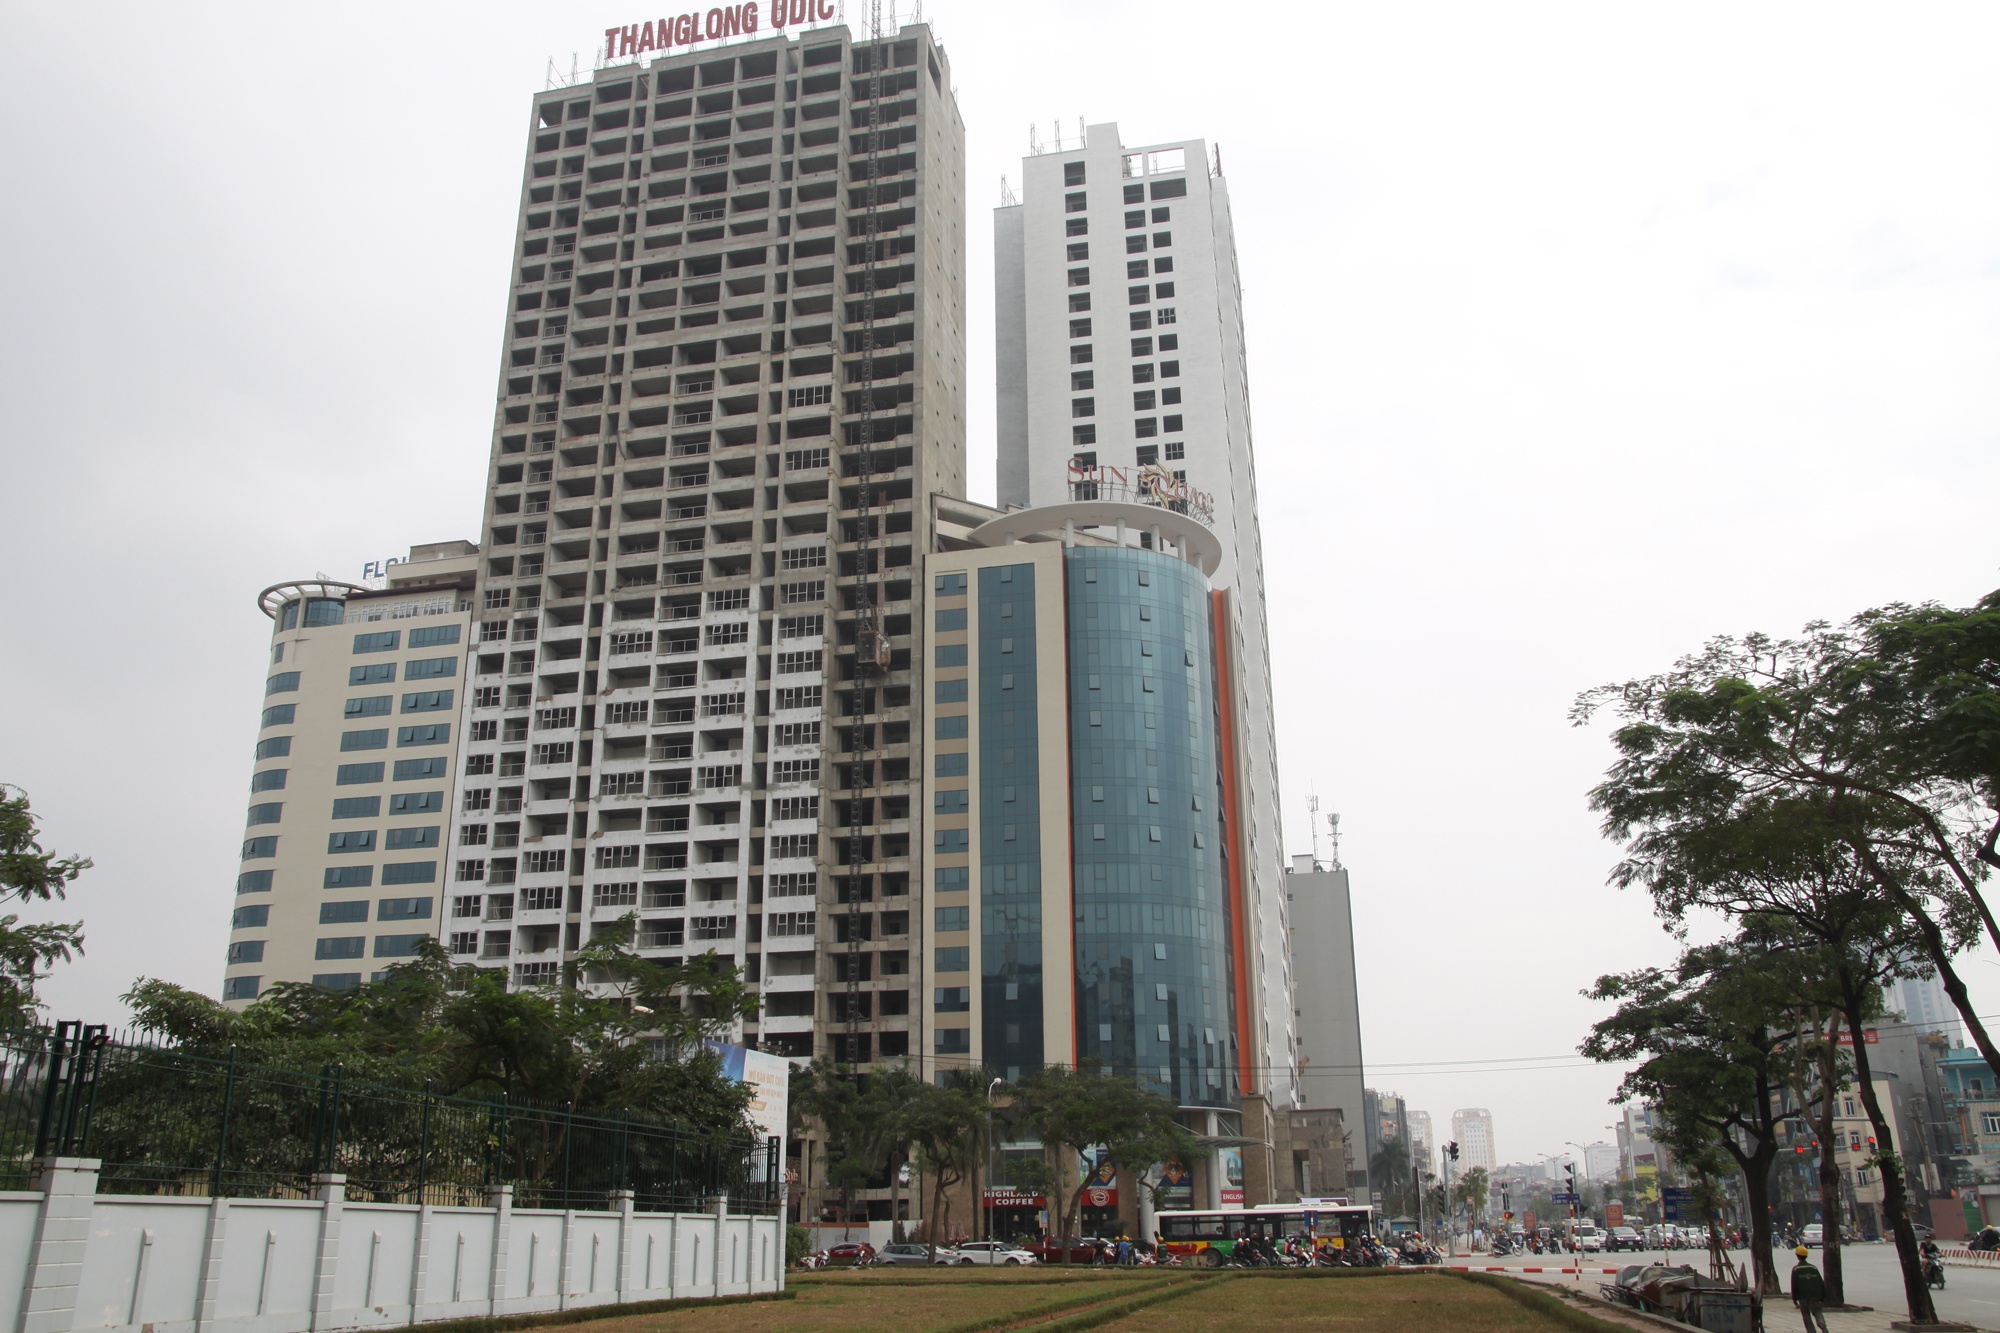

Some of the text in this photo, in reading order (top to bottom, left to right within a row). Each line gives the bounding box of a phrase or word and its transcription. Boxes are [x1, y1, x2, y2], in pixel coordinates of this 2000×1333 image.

[605, 0, 836, 59] THANGLONG UDIC
[984, 1190, 1042, 1198] HIGHLAND
[995, 1198, 1034, 1206] COFFEE
